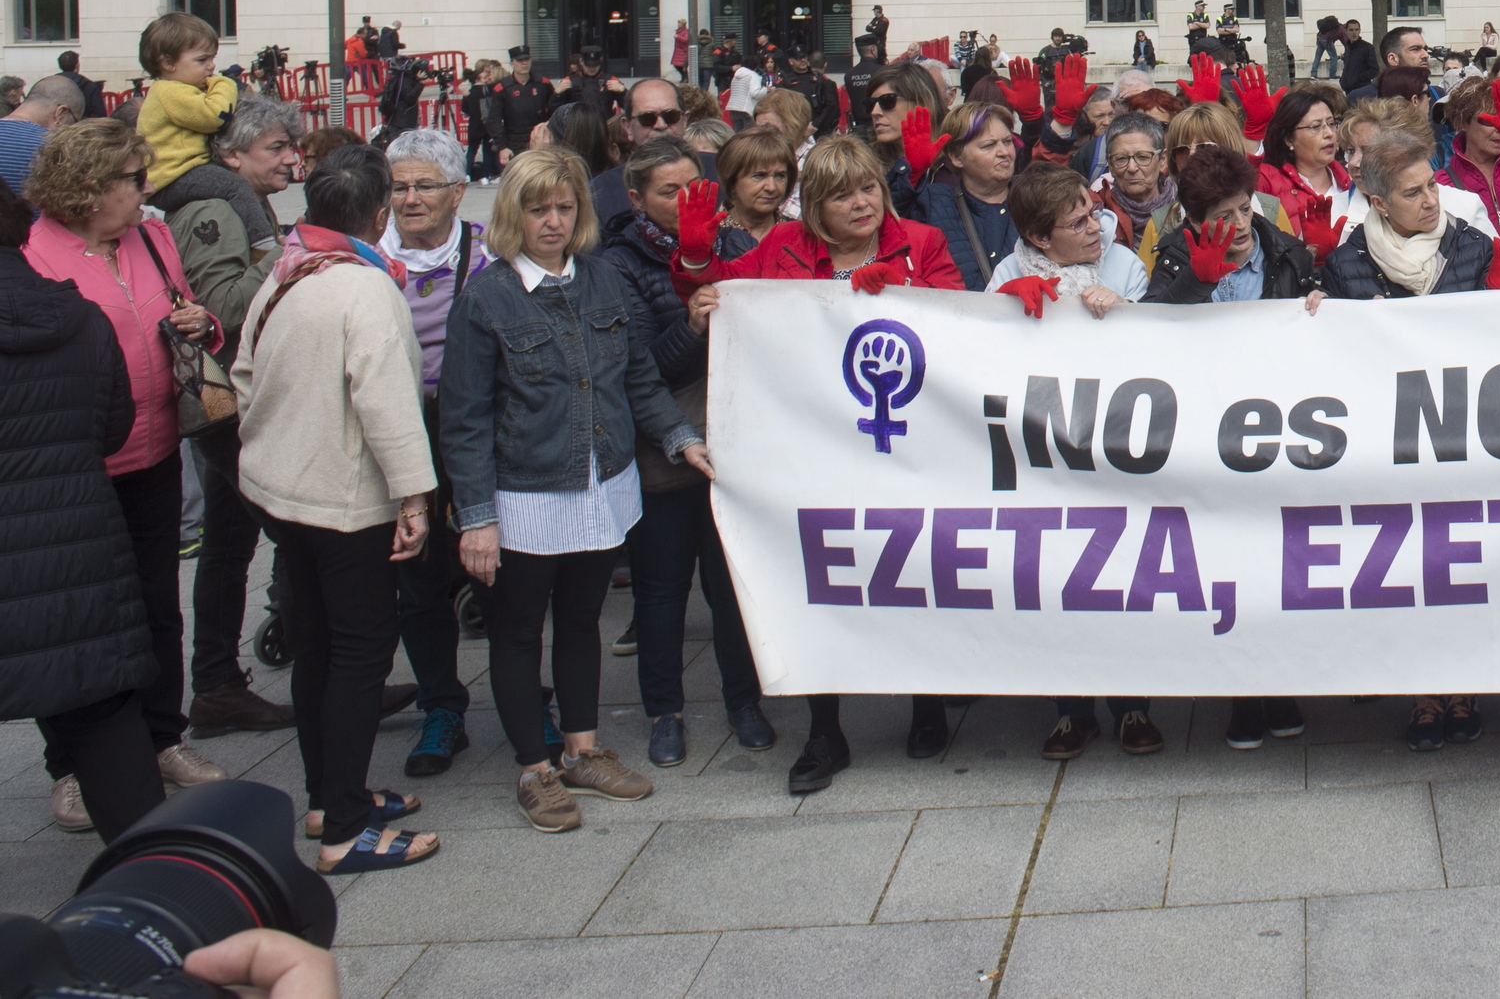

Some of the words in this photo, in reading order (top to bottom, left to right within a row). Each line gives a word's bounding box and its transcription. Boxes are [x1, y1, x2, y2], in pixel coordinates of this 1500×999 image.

[984, 374, 1178, 491] ¡NO
[1217, 396, 1348, 473] es
[797, 506, 1237, 636] EZETZA,
